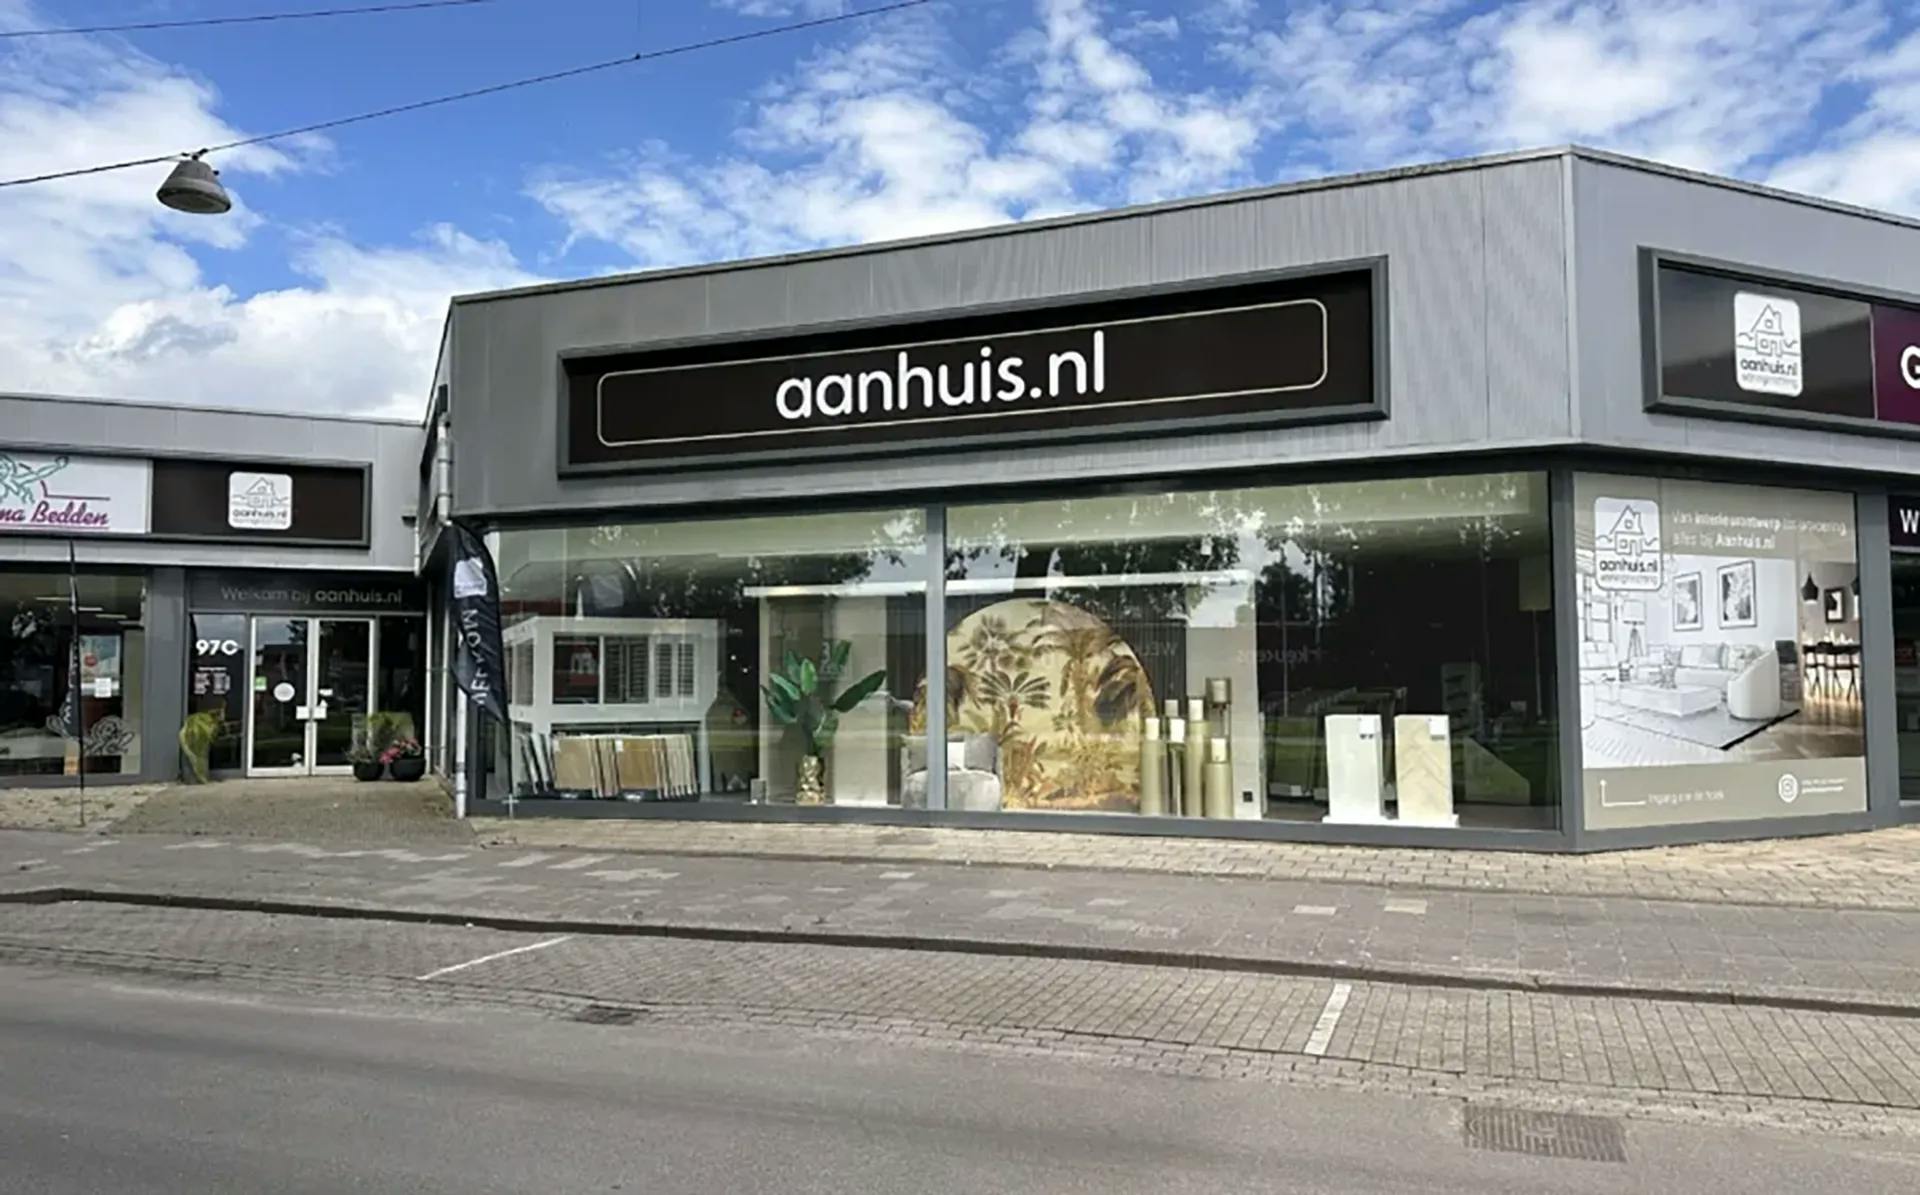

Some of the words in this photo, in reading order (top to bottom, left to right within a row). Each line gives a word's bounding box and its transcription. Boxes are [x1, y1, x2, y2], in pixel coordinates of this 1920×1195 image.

[776, 330, 1104, 419] aanhuis.nl
[1741, 358, 1798, 376] aanhuis.nl
[31, 501, 108, 525] Bedden
[1600, 559, 1658, 572] aanhuis.nl
[315, 589, 403, 604] aanhuis.nl
[196, 640, 239, 655] 97C
